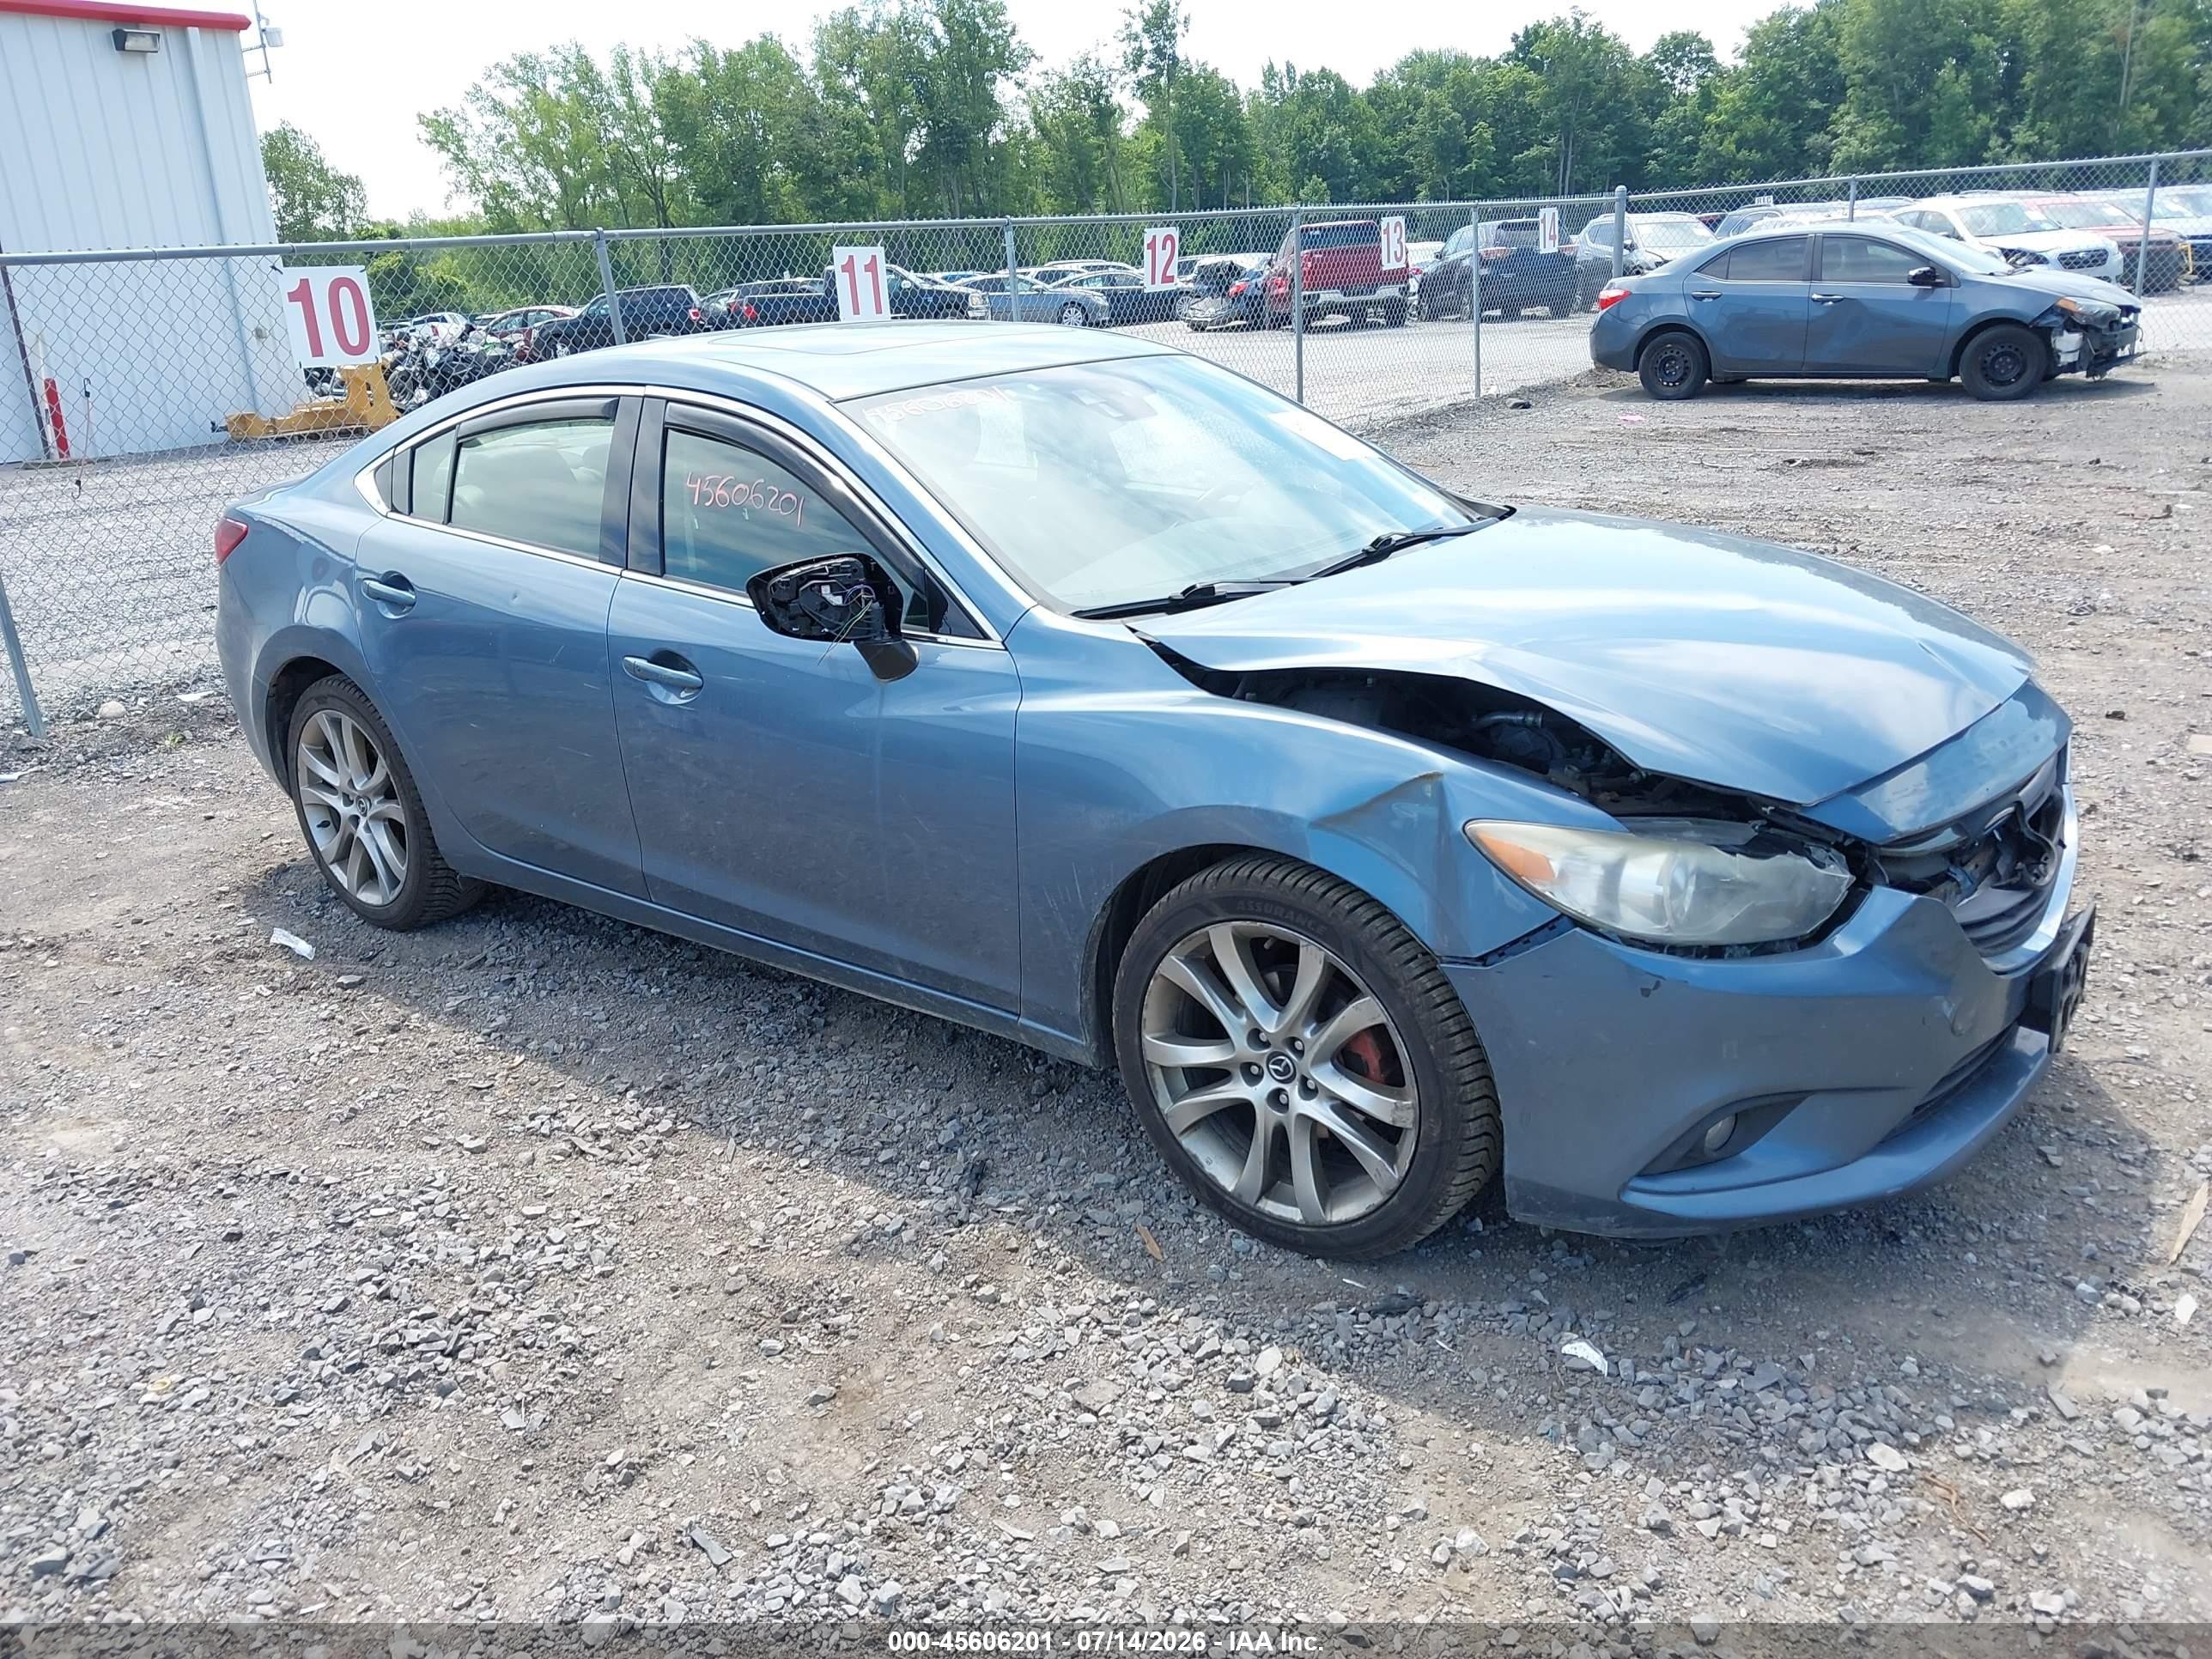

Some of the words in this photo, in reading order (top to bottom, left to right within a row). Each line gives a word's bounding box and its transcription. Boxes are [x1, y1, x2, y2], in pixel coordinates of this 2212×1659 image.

[1383, 221, 1403, 263] 13
[1540, 211, 1557, 248] 14
[841, 254, 882, 315] 11
[1147, 234, 1176, 285] 12
[287, 276, 370, 357] 10
[685, 471, 804, 527] 45606201
[1237, 899, 1327, 935] ASSURANCE
